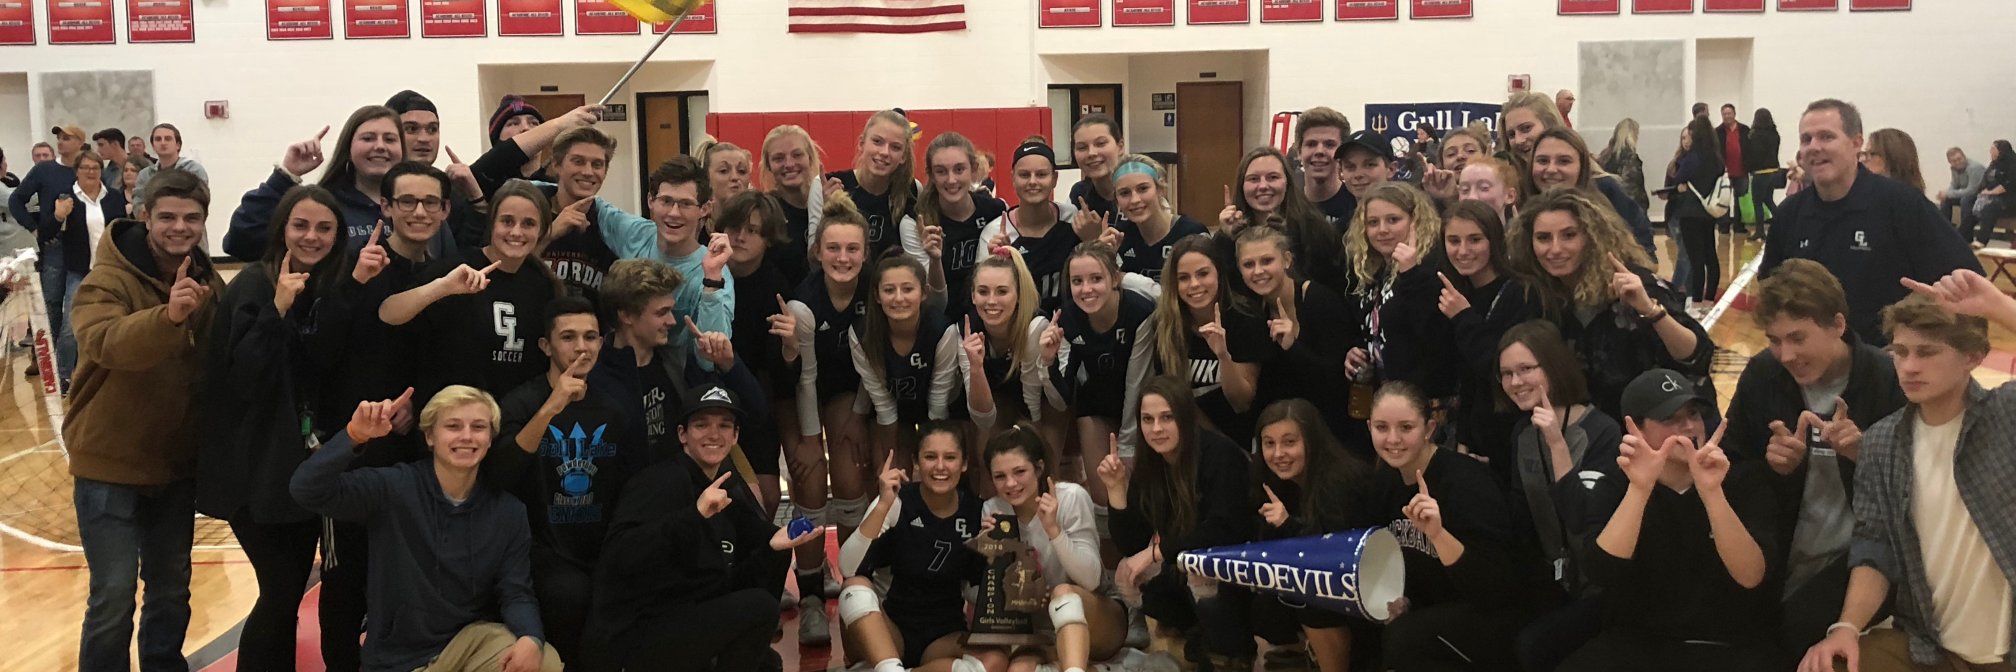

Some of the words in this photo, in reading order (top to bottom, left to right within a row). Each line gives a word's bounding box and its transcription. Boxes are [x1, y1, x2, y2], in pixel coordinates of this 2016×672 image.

[1397, 110, 1453, 131] Gull
[493, 300, 525, 352] GL
[492, 350, 523, 363] SOCCER
[954, 518, 973, 538] GL
[927, 539, 952, 572] 7
[986, 568, 996, 615] CHAMPION
[1184, 553, 1254, 587] BLUE
[1251, 561, 1358, 601] DEVILS
